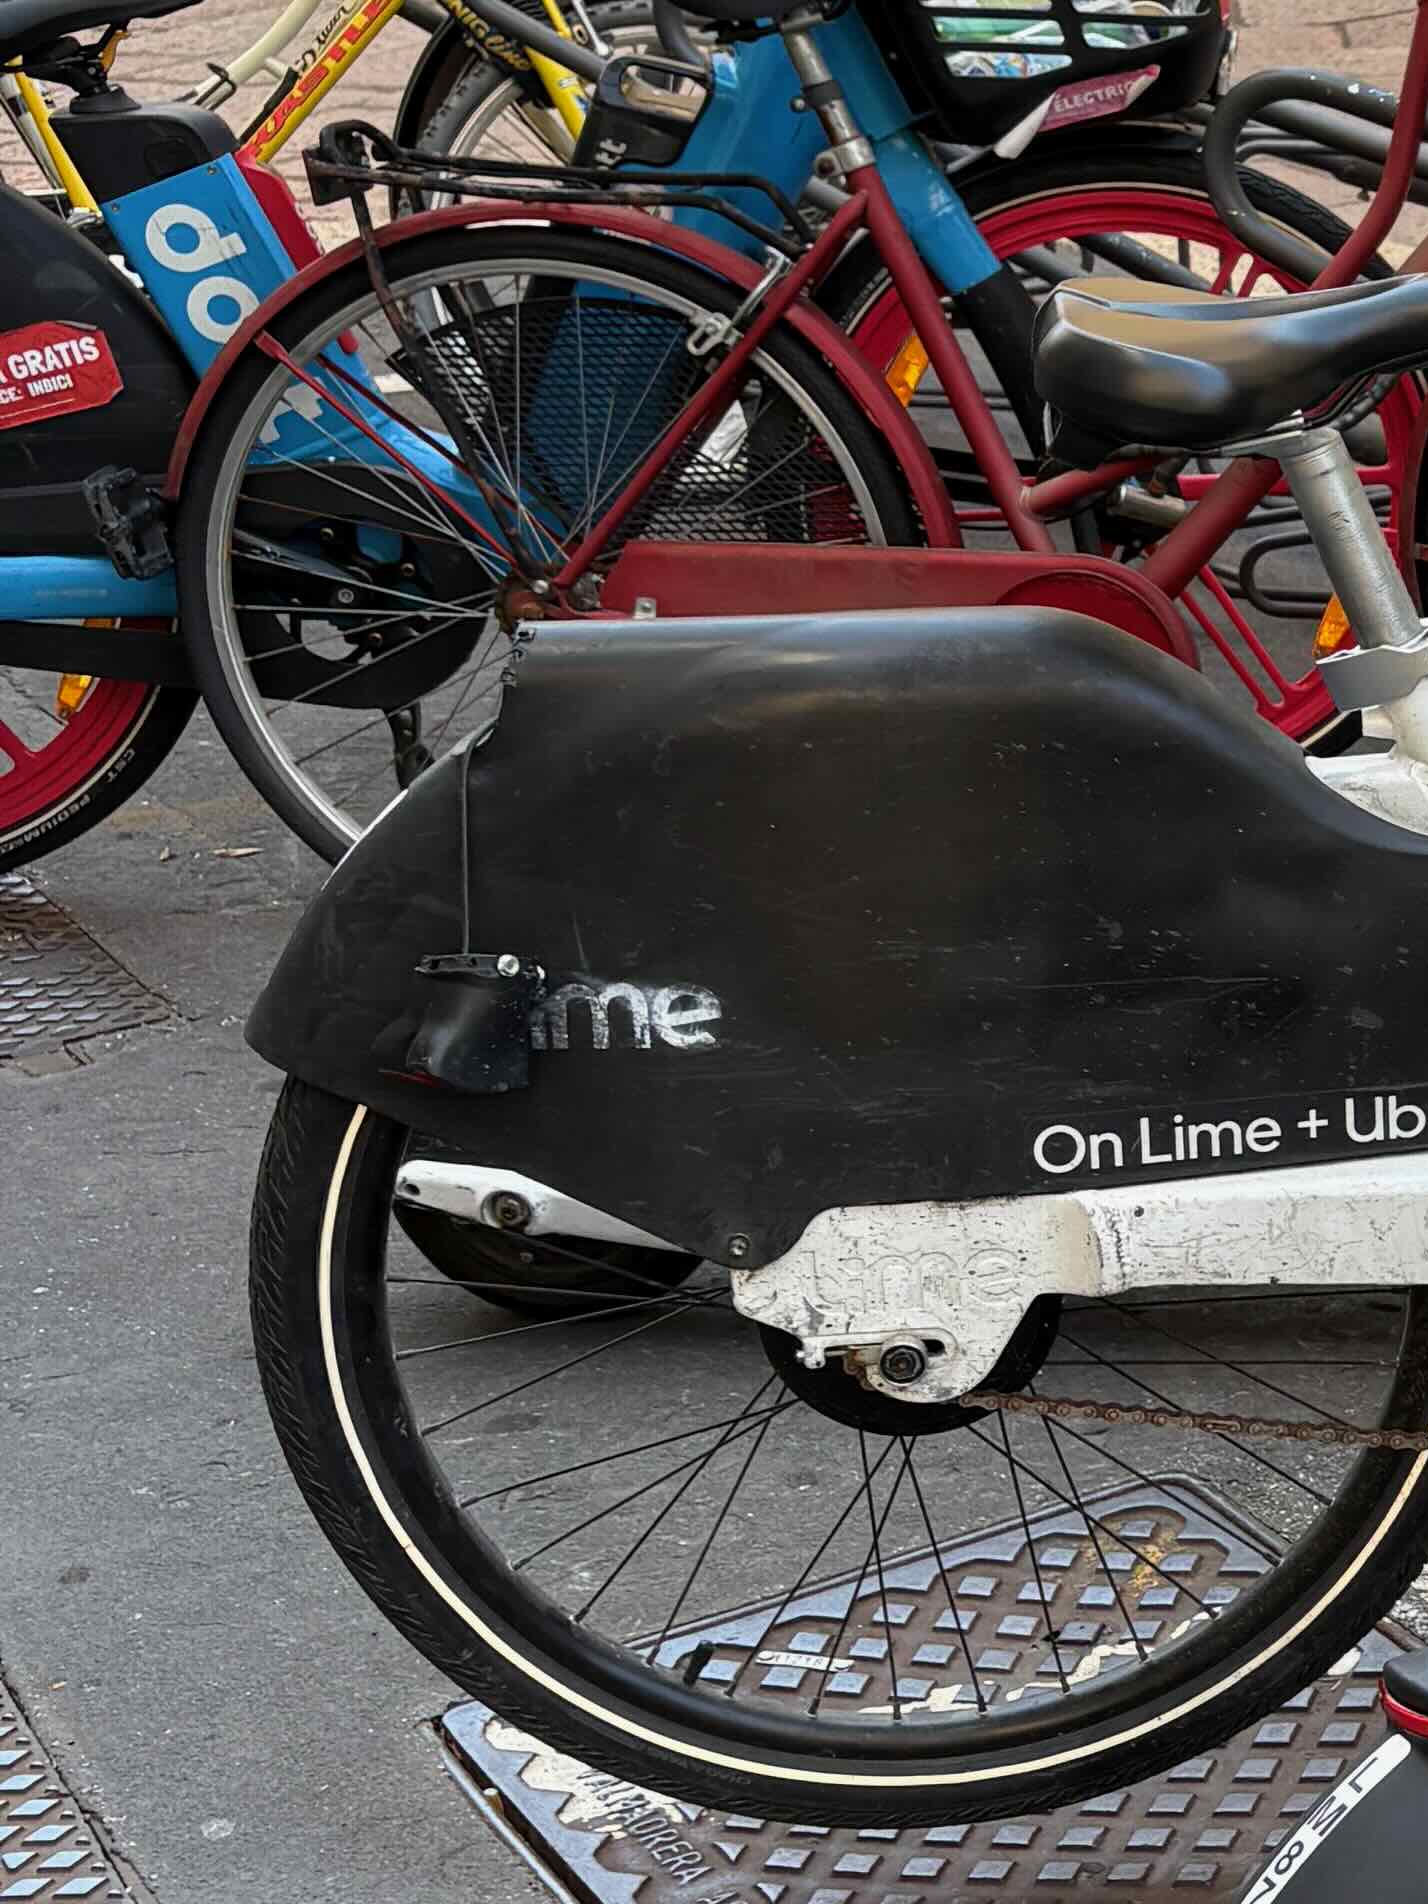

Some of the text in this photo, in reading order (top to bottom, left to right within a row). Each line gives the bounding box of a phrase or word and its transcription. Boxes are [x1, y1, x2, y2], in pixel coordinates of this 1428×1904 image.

[7, 336, 100, 380] GRATIS
[530, 981, 722, 1051] ime
[1033, 1124, 1124, 1174] On
[1139, 1113, 1282, 1165] Lime
[1296, 1109, 1329, 1139] +
